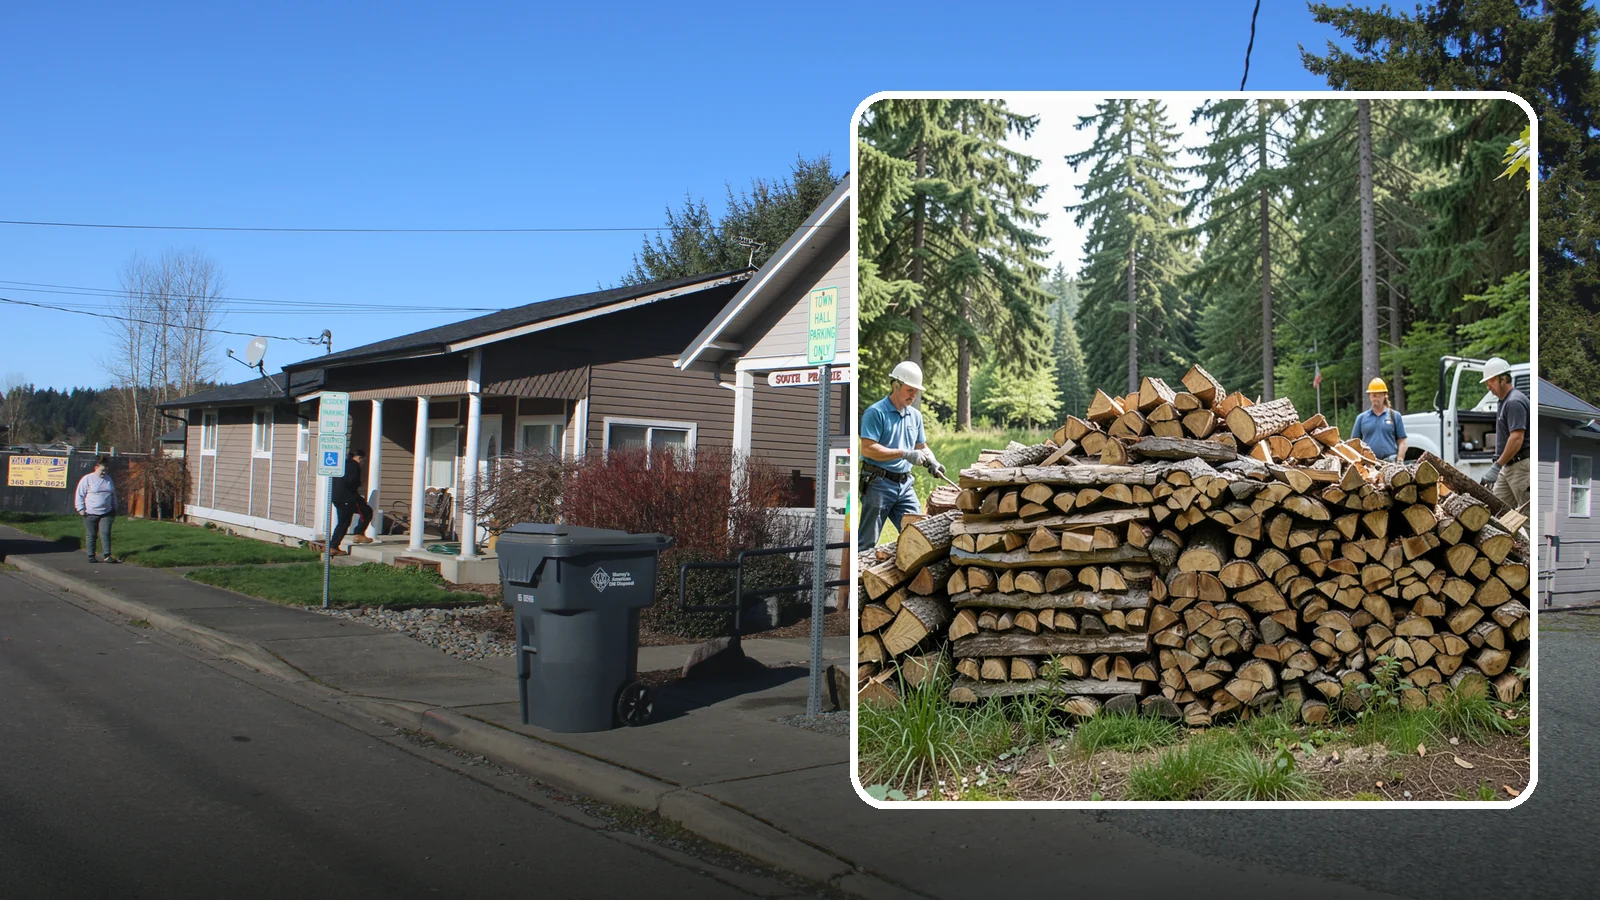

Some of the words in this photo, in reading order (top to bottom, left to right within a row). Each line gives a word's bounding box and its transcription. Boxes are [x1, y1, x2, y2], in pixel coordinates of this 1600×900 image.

[815, 295, 833, 308] TOWN
[814, 311, 831, 324] HALL
[810, 327, 836, 340] PARKING
[813, 344, 831, 357] ONLY
[775, 373, 801, 384] SOUTH
